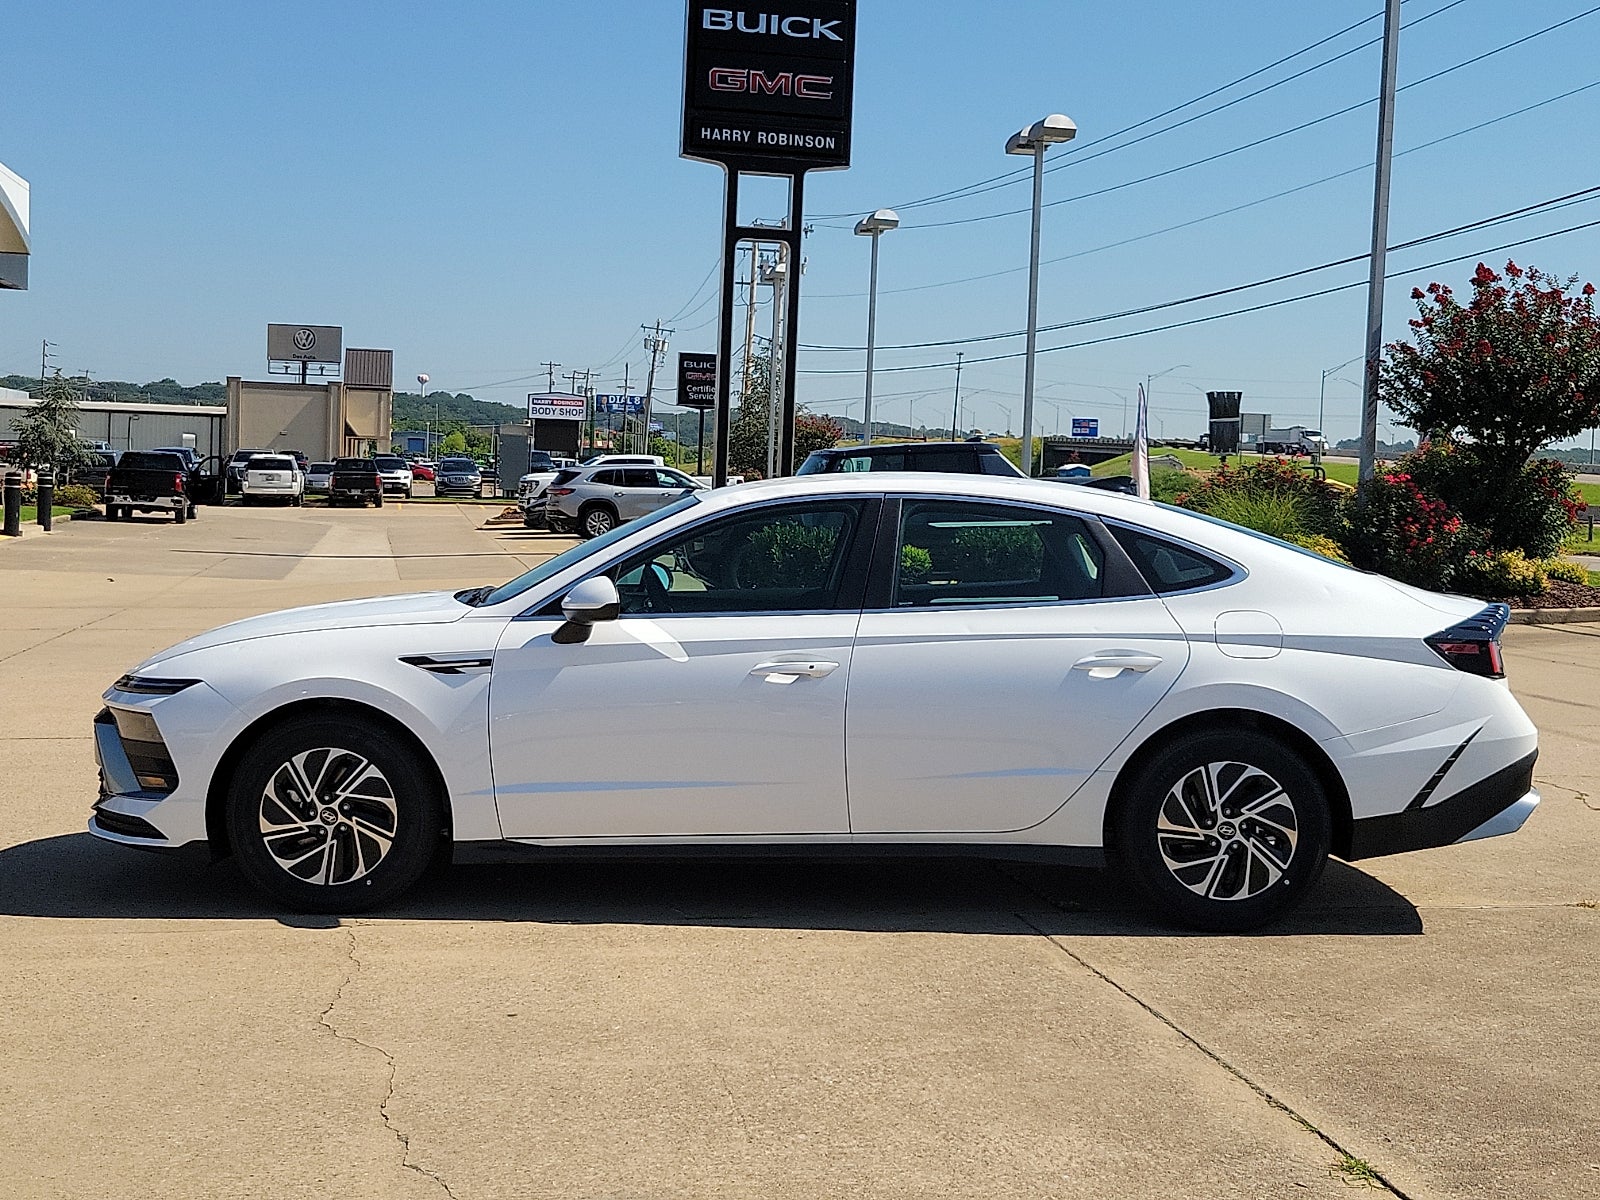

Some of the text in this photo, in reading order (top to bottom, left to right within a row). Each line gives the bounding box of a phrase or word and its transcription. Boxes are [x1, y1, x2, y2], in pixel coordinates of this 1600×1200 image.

[702, 9, 843, 41] BUICK
[709, 67, 833, 99] GMC
[701, 127, 835, 149] HARRY ROBINSON
[683, 361, 716, 369] BUIC
[686, 385, 716, 393] Certifie
[531, 406, 584, 417] BODY SHOP
